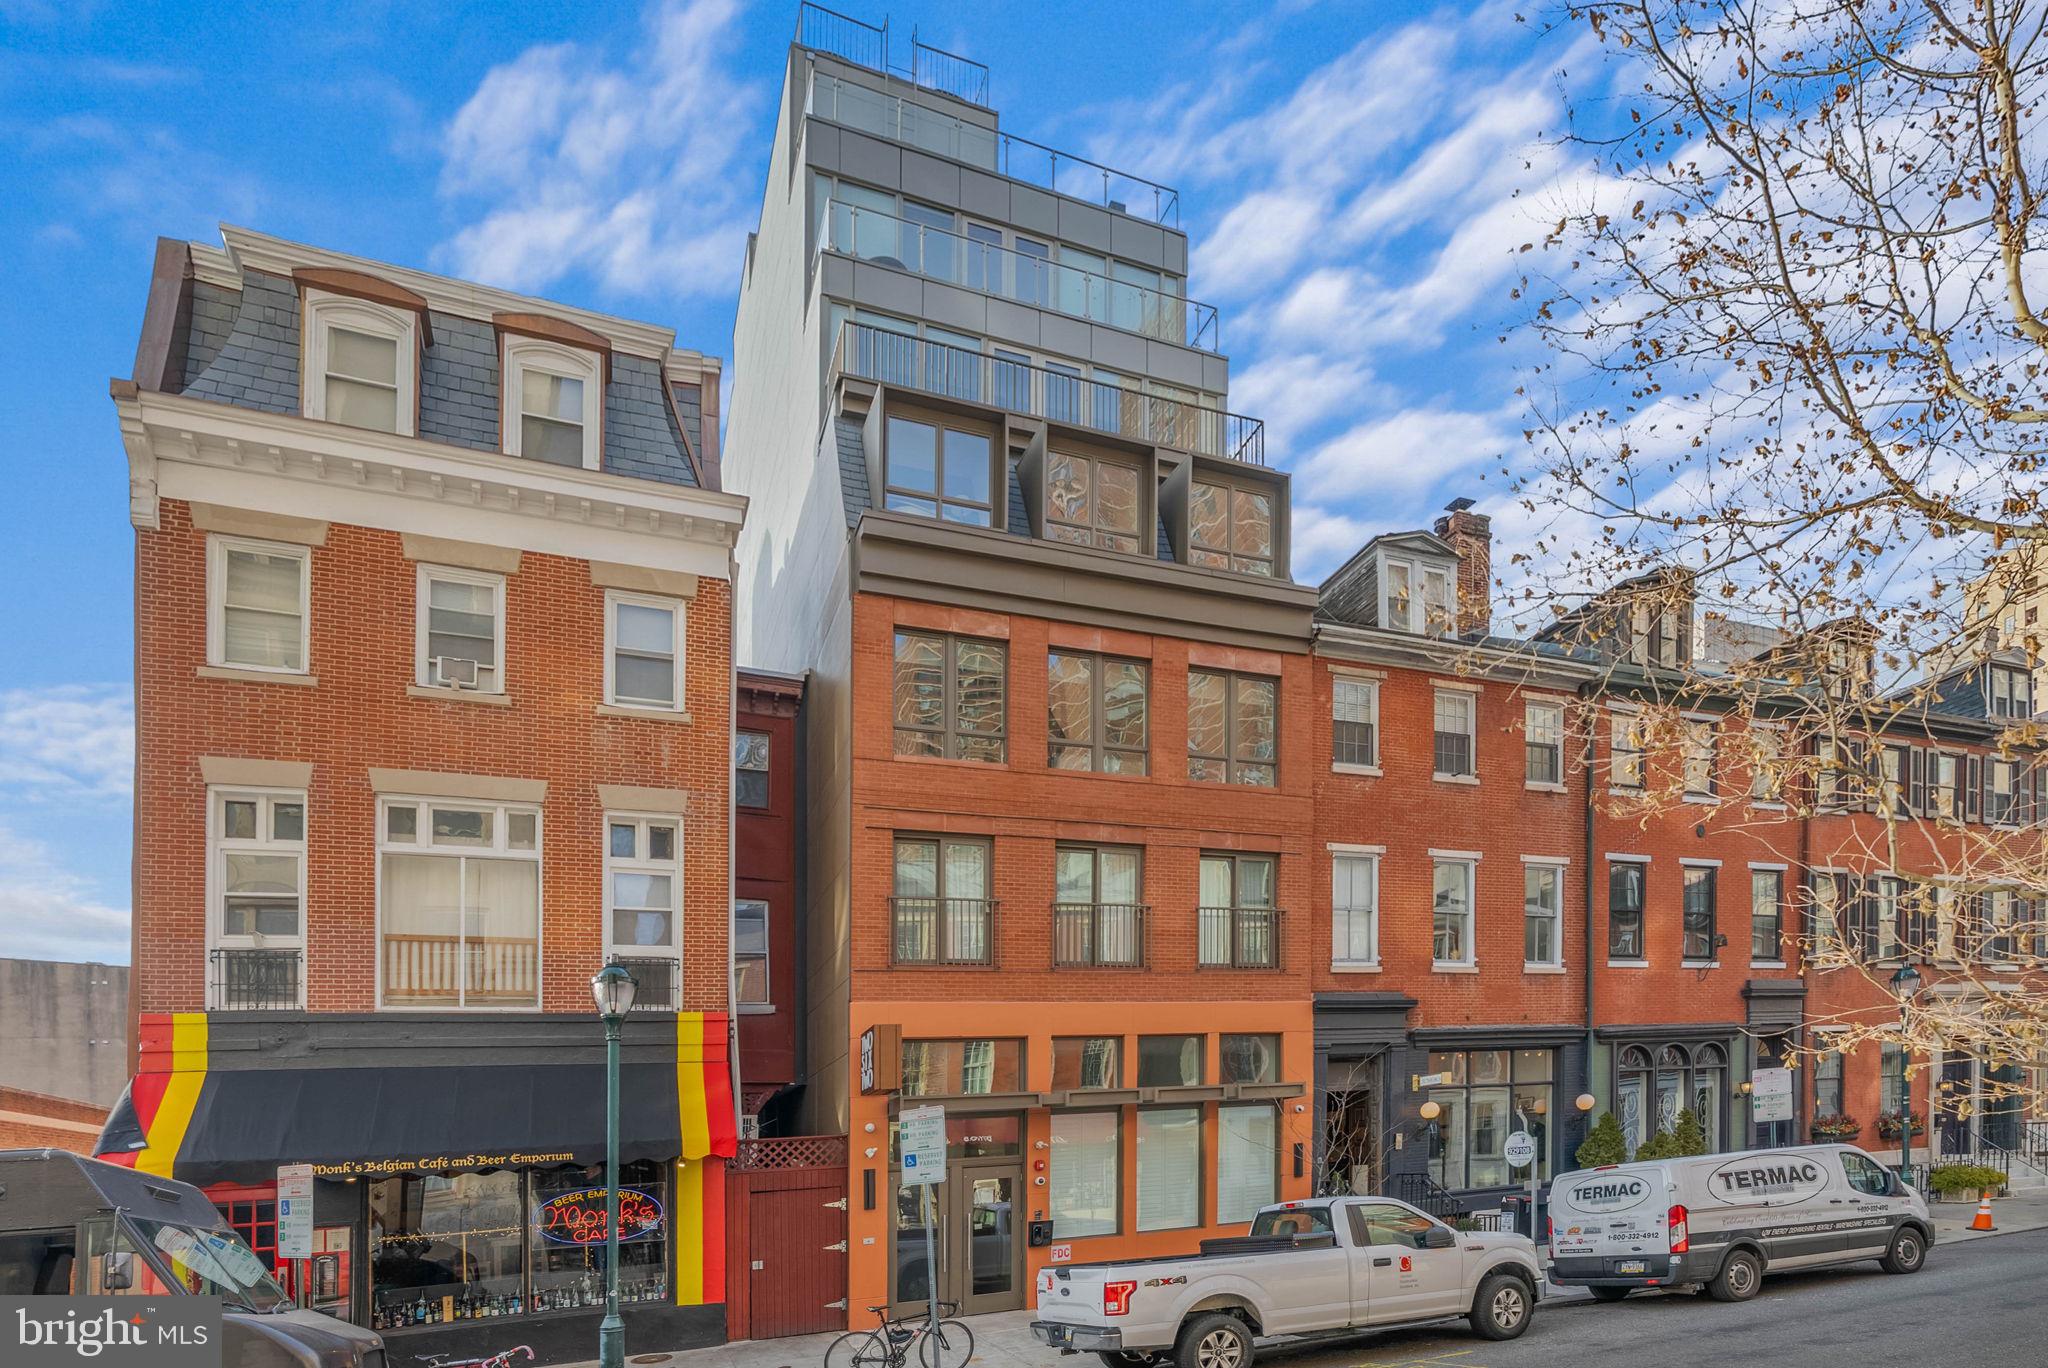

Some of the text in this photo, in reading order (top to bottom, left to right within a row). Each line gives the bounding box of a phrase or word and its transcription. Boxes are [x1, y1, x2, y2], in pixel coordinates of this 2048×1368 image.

[312, 1160, 362, 1175] Monk's
[364, 1158, 416, 1174] Belgian
[418, 1156, 450, 1173] Café
[451, 1154, 475, 1167] and
[477, 1154, 506, 1167] Beer
[509, 1151, 575, 1165] Emporium
[1718, 1163, 1818, 1190] TERMAC
[554, 1190, 644, 1208] BEER EMPRIUM
[1573, 1182, 1642, 1201] TERMAC
[1607, 1231, 1660, 1241] 1-800-332-4912
[1052, 1247, 1070, 1259] FDC
